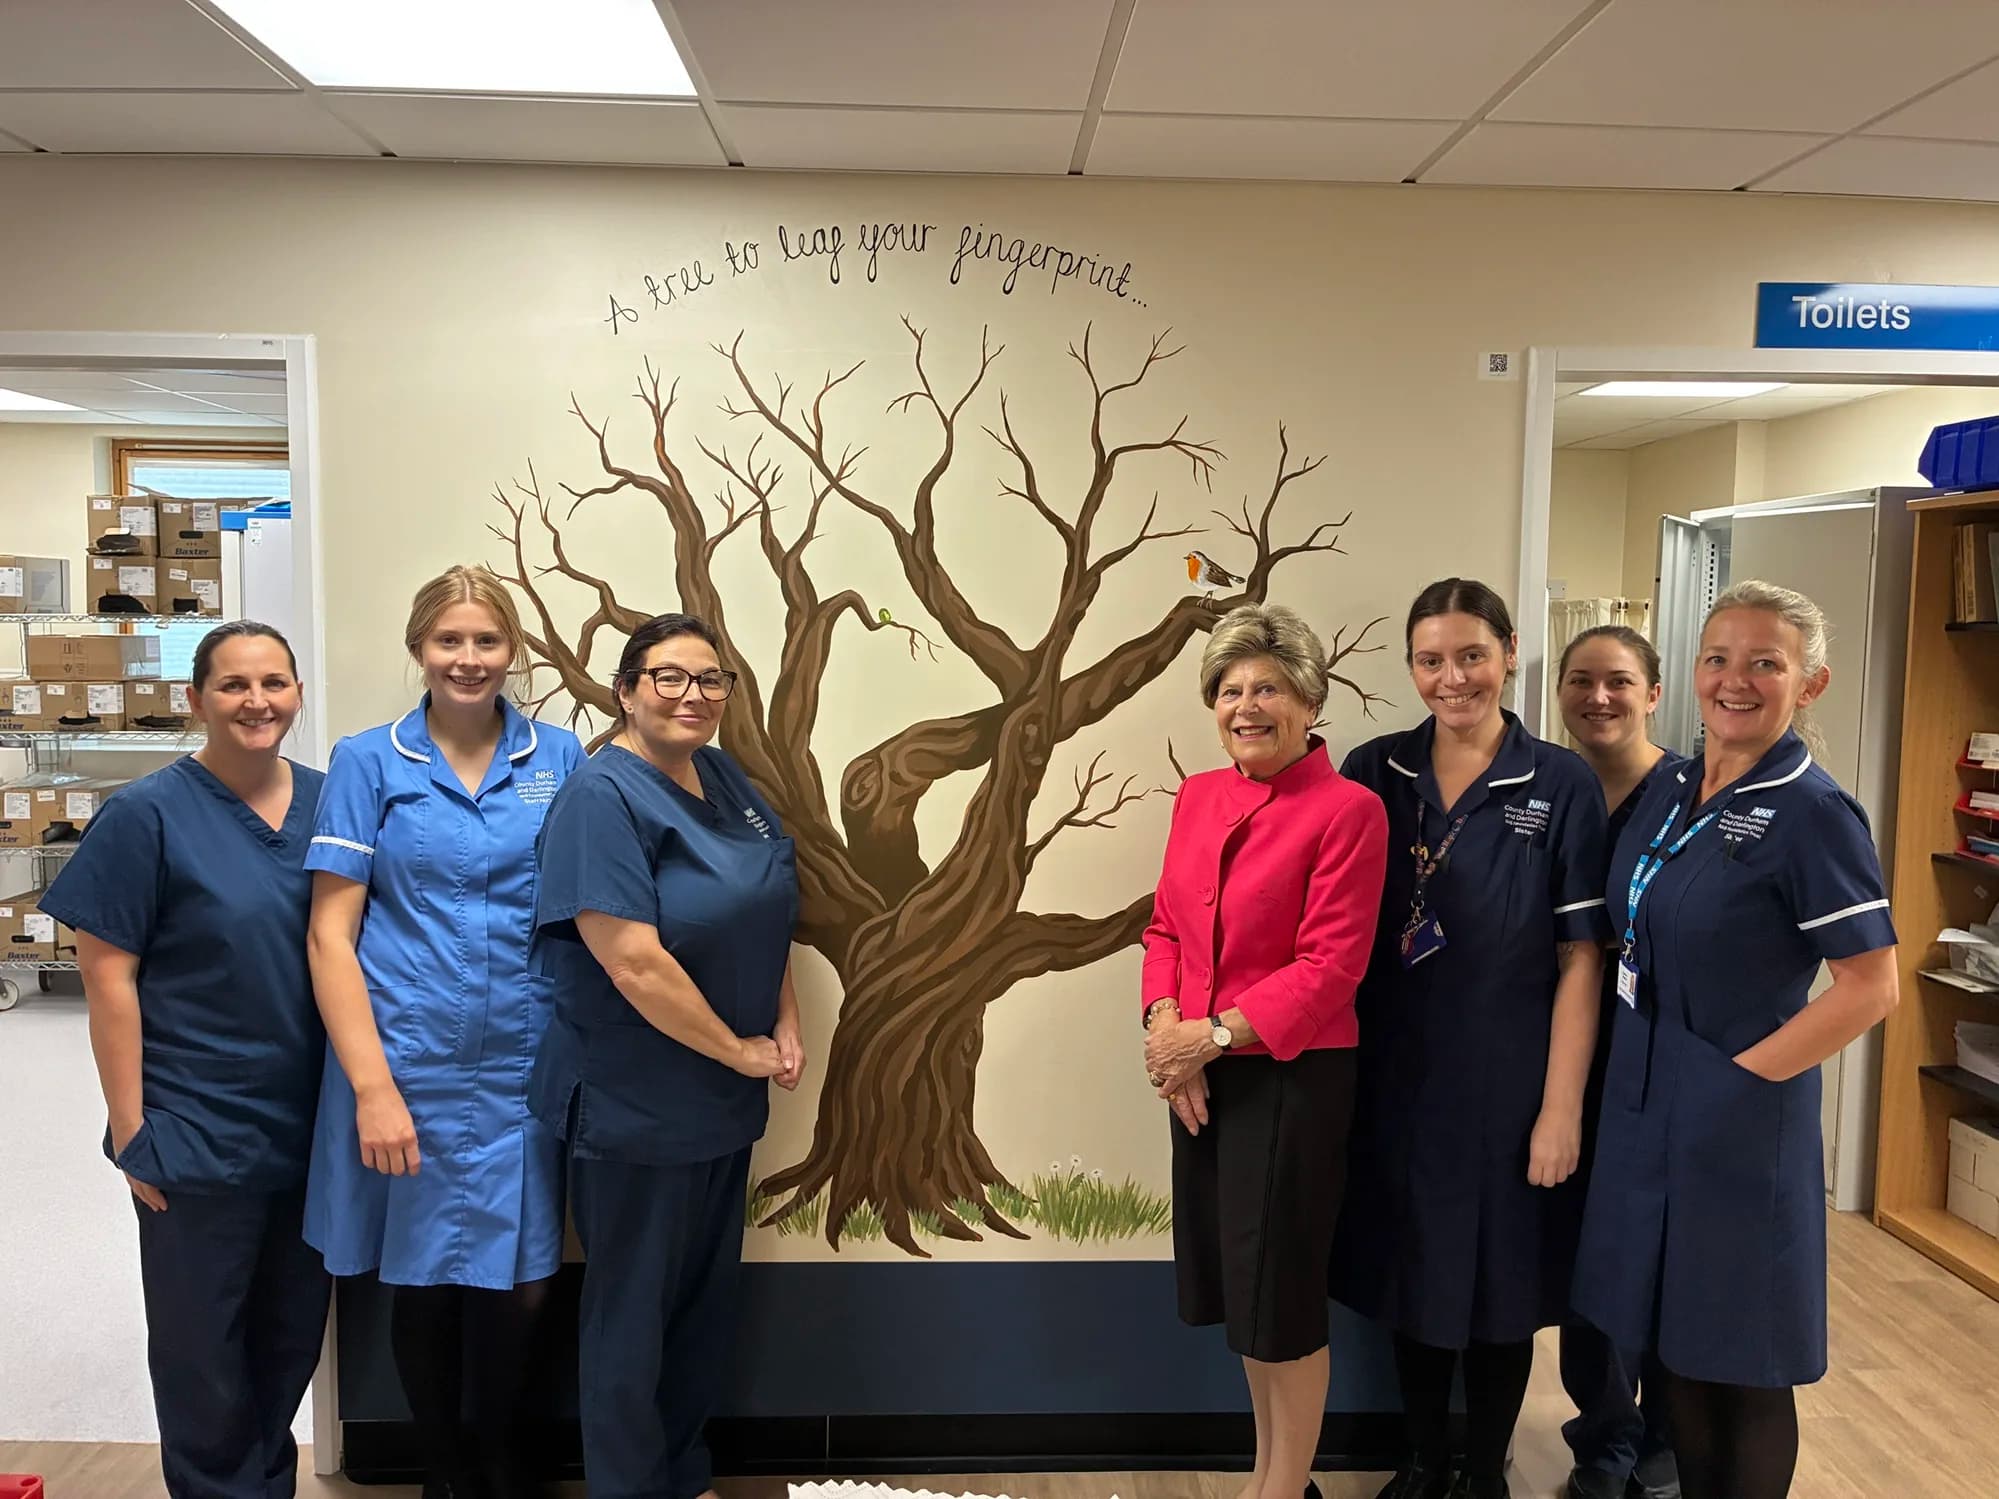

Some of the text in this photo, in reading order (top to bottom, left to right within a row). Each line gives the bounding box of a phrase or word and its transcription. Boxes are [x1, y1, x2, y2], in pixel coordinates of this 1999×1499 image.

[603, 294, 639, 335] A
[644, 260, 714, 311] tree
[725, 241, 759, 277] to
[778, 225, 846, 284] leaf
[857, 223, 937, 283] your
[1792, 296, 1911, 330] Toilets
[536, 769, 554, 780] NHS
[1504, 804, 1525, 815] County
[1528, 799, 1551, 811] NHS
[1750, 807, 1776, 819] NHS
[1505, 812, 1516, 820] and
[1723, 809, 1744, 821] County
[1656, 824, 1668, 841] NHS
[1720, 818, 1765, 835] and Darlington
[1677, 830, 1694, 846] NHS
[1633, 863, 1644, 881] NHS
[1643, 868, 1657, 884] NHS
